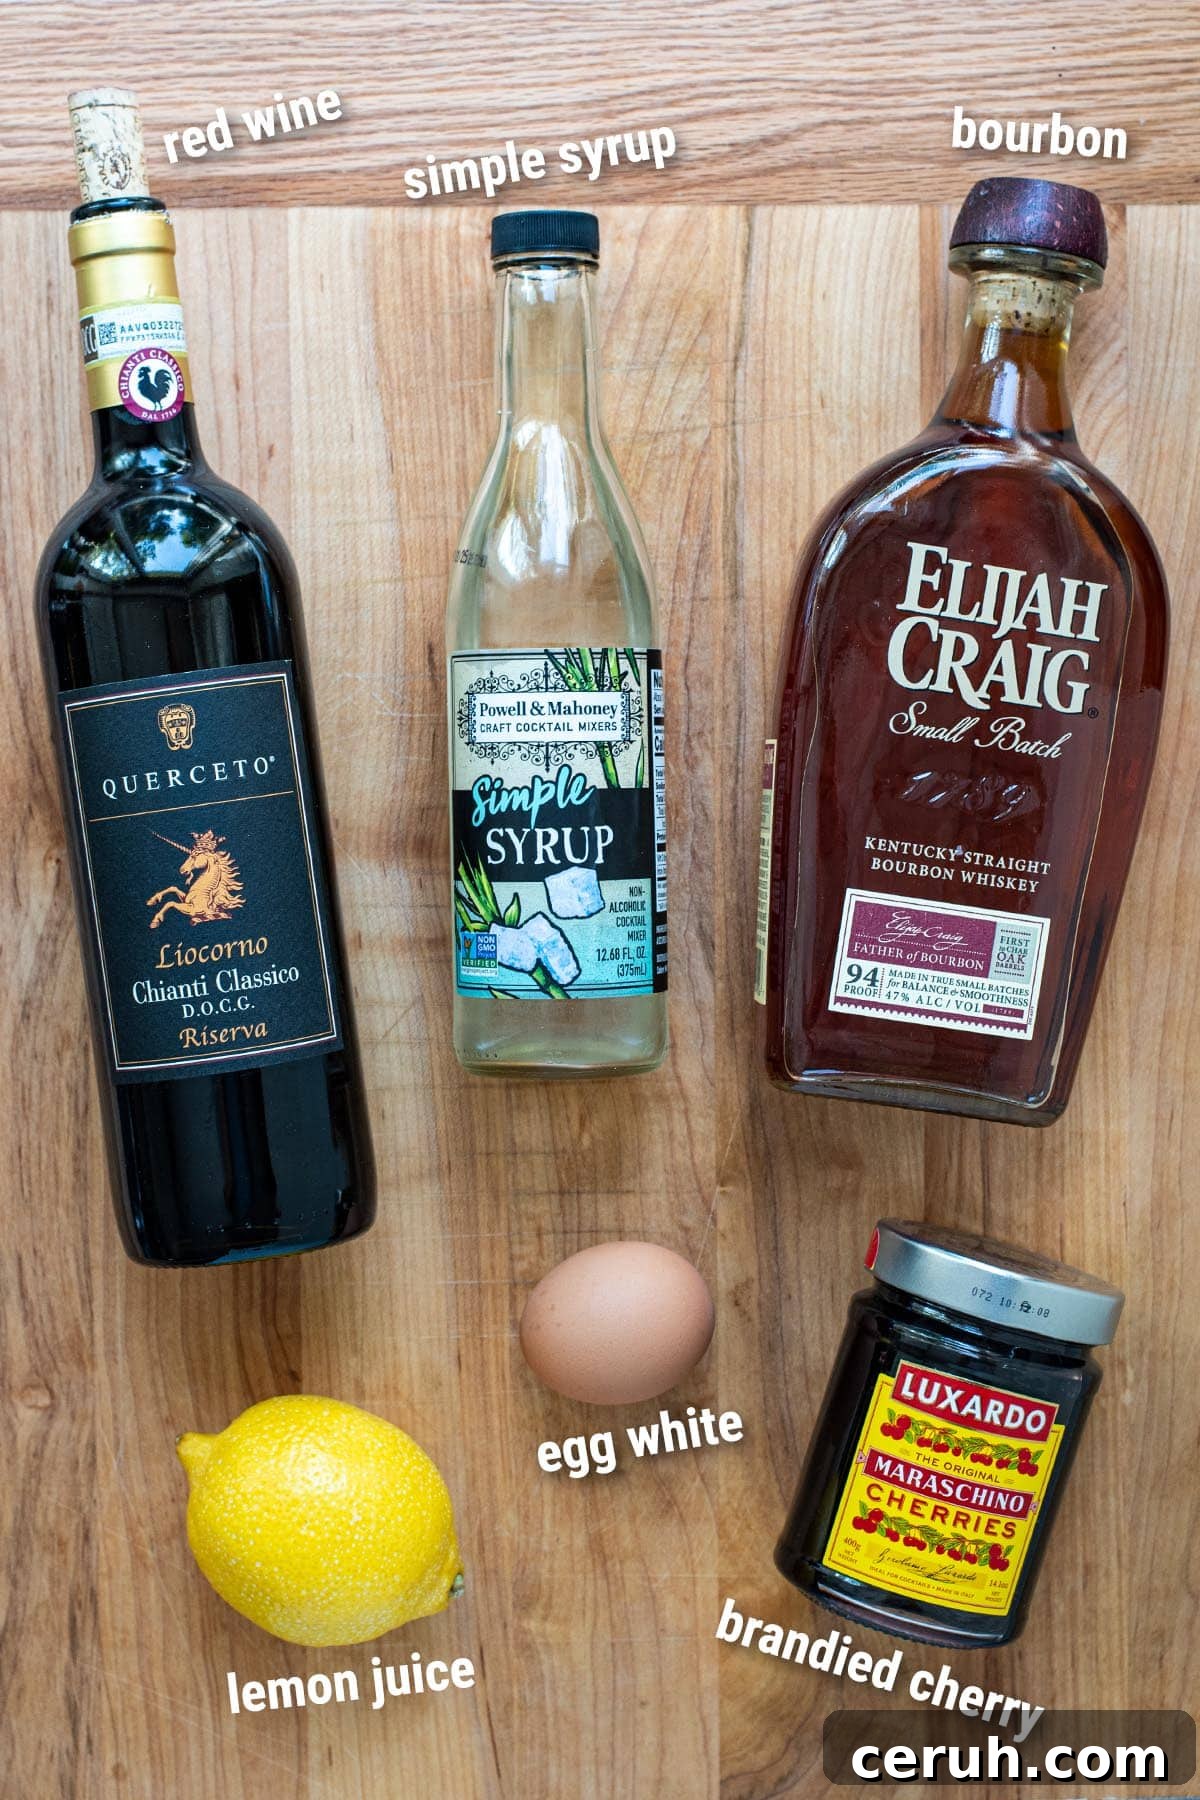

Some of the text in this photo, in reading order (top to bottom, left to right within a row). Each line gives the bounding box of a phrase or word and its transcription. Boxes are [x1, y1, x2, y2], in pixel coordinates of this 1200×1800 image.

[120, 349, 184, 398] CHIANTI CLASSICO
[141, 411, 158, 420] DAL
[895, 541, 1109, 643] ELIJAH
[886, 615, 1090, 715] CRAIG
[479, 700, 618, 719] Powell & Mahoney
[480, 721, 618, 733] CRAFT COCKTAIL MIXERS
[889, 701, 1072, 759] Small Batch
[102, 755, 269, 799] QUERCETO
[472, 764, 596, 830] Simple
[486, 825, 614, 865] SYRUP
[864, 836, 1051, 875] KENTUCKY STRAIGHT
[871, 857, 1040, 893] BOURBON WHISKEY
[628, 886, 646, 896] NON-
[609, 899, 647, 913] ALCOHOLIC
[615, 915, 647, 927] COCKTAIL
[477, 935, 495, 944] NON
[477, 943, 496, 952] GMO
[627, 930, 647, 942] MIXER
[999, 935, 1030, 947] FIRST
[155, 936, 268, 969] Liocorno
[462, 959, 497, 968] VERIFIED
[595, 948, 620, 962] 12.68
[853, 942, 984, 971] FATHER of BOURBON
[997, 952, 1026, 965] OAK
[132, 965, 300, 1005] Chianti Classico
[846, 963, 880, 988] 94
[888, 970, 1030, 997] MADE IN TRUE SMALL BATCHES
[843, 984, 879, 998] PROOF
[884, 991, 910, 1002] 47%
[886, 979, 1029, 1008] for BALANCE & SMOOTHNESS
[181, 999, 256, 1019] D.O.C.G.
[178, 1021, 268, 1049] Riserva
[971, 1286, 993, 1302] 072
[900, 1373, 1048, 1434] LUXARDO
[915, 1452, 1001, 1484] THE ORIGINAL
[873, 1455, 1025, 1513] MARASCHINO
[866, 1483, 1017, 1539] CHERRIES
